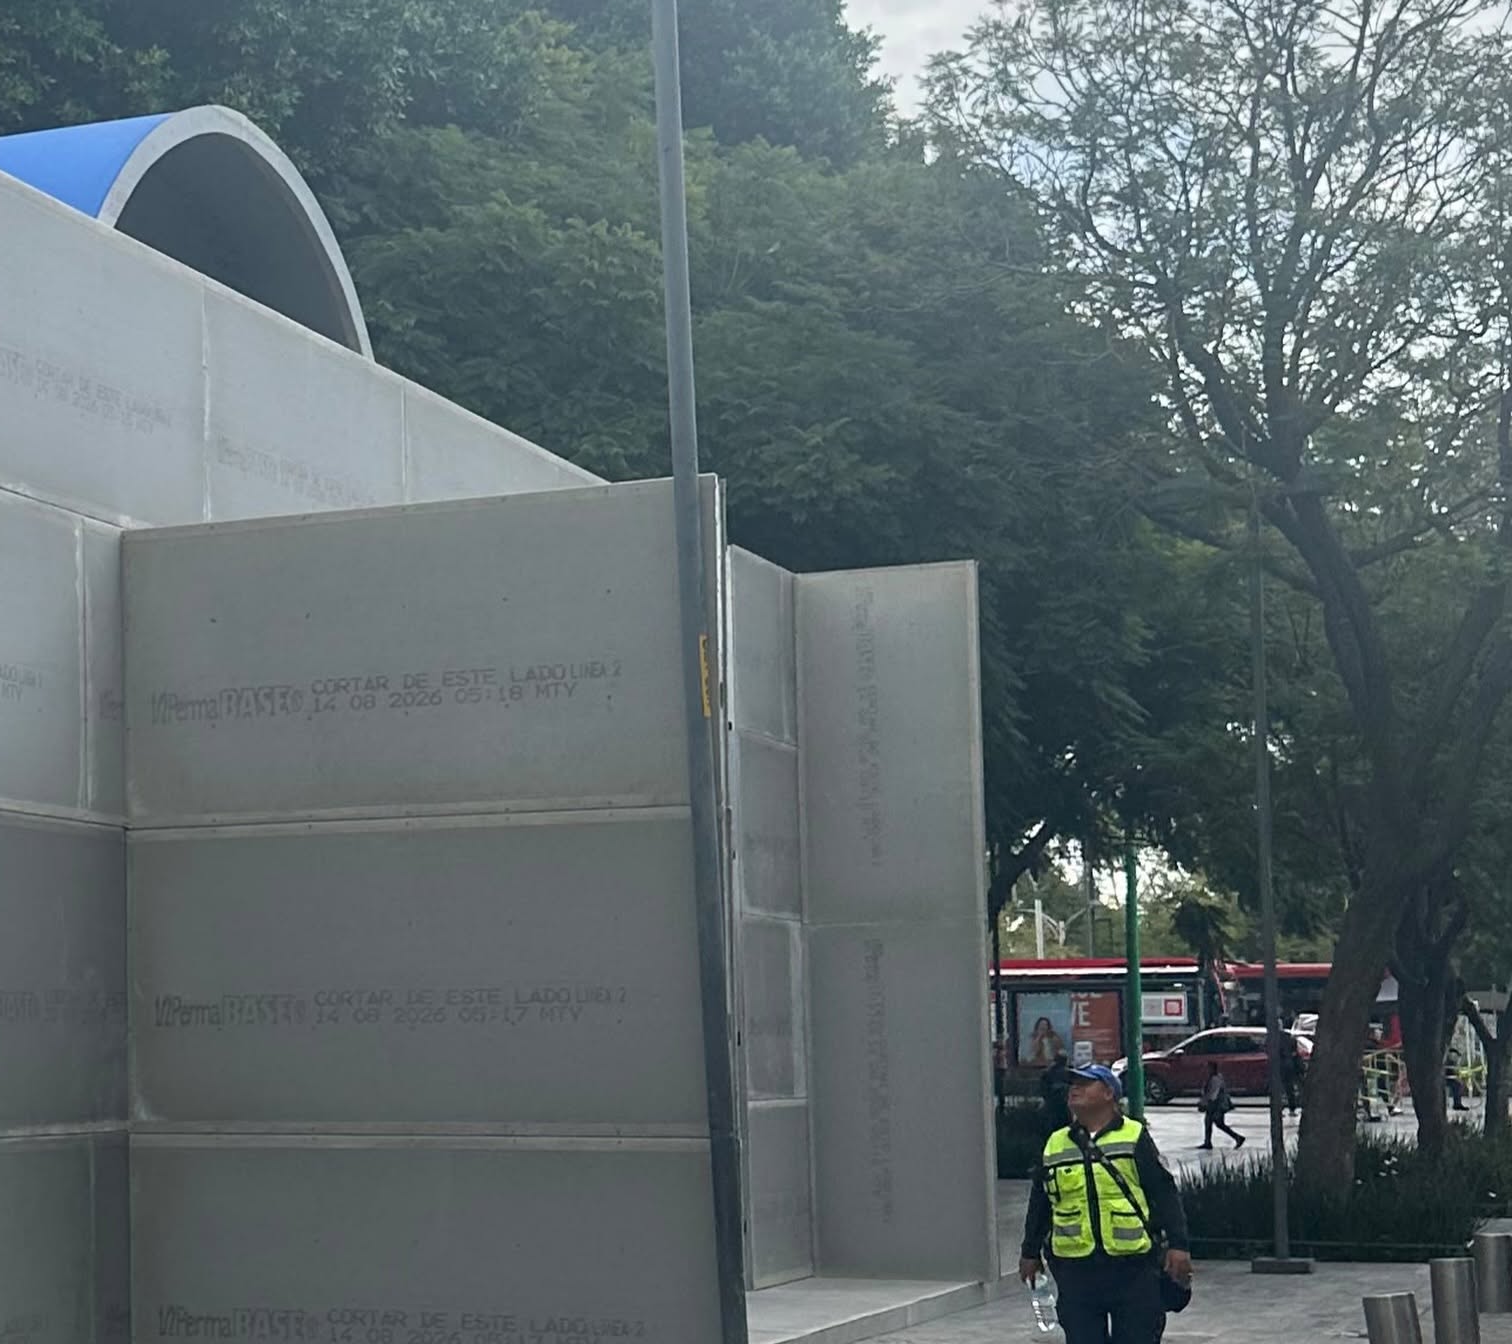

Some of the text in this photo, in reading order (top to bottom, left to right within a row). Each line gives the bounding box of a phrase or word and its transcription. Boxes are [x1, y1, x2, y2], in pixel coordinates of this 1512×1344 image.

[310, 674, 389, 697] CORTAR
[402, 671, 430, 690] DE
[441, 667, 497, 688] ESTE
[510, 662, 567, 683] LADO
[349, 692, 377, 711] 08
[388, 688, 443, 709] 2026
[535, 681, 578, 700] MTY
[313, 989, 393, 1008] CORTAR
[406, 988, 434, 1006] DE
[445, 987, 502, 1005] ESTE
[514, 986, 571, 1005] LADO
[393, 1006, 448, 1025] 2026
[326, 1308, 409, 1328] CORTAR
[460, 1312, 517, 1333] ESTE
[529, 1316, 588, 1335] LADO
